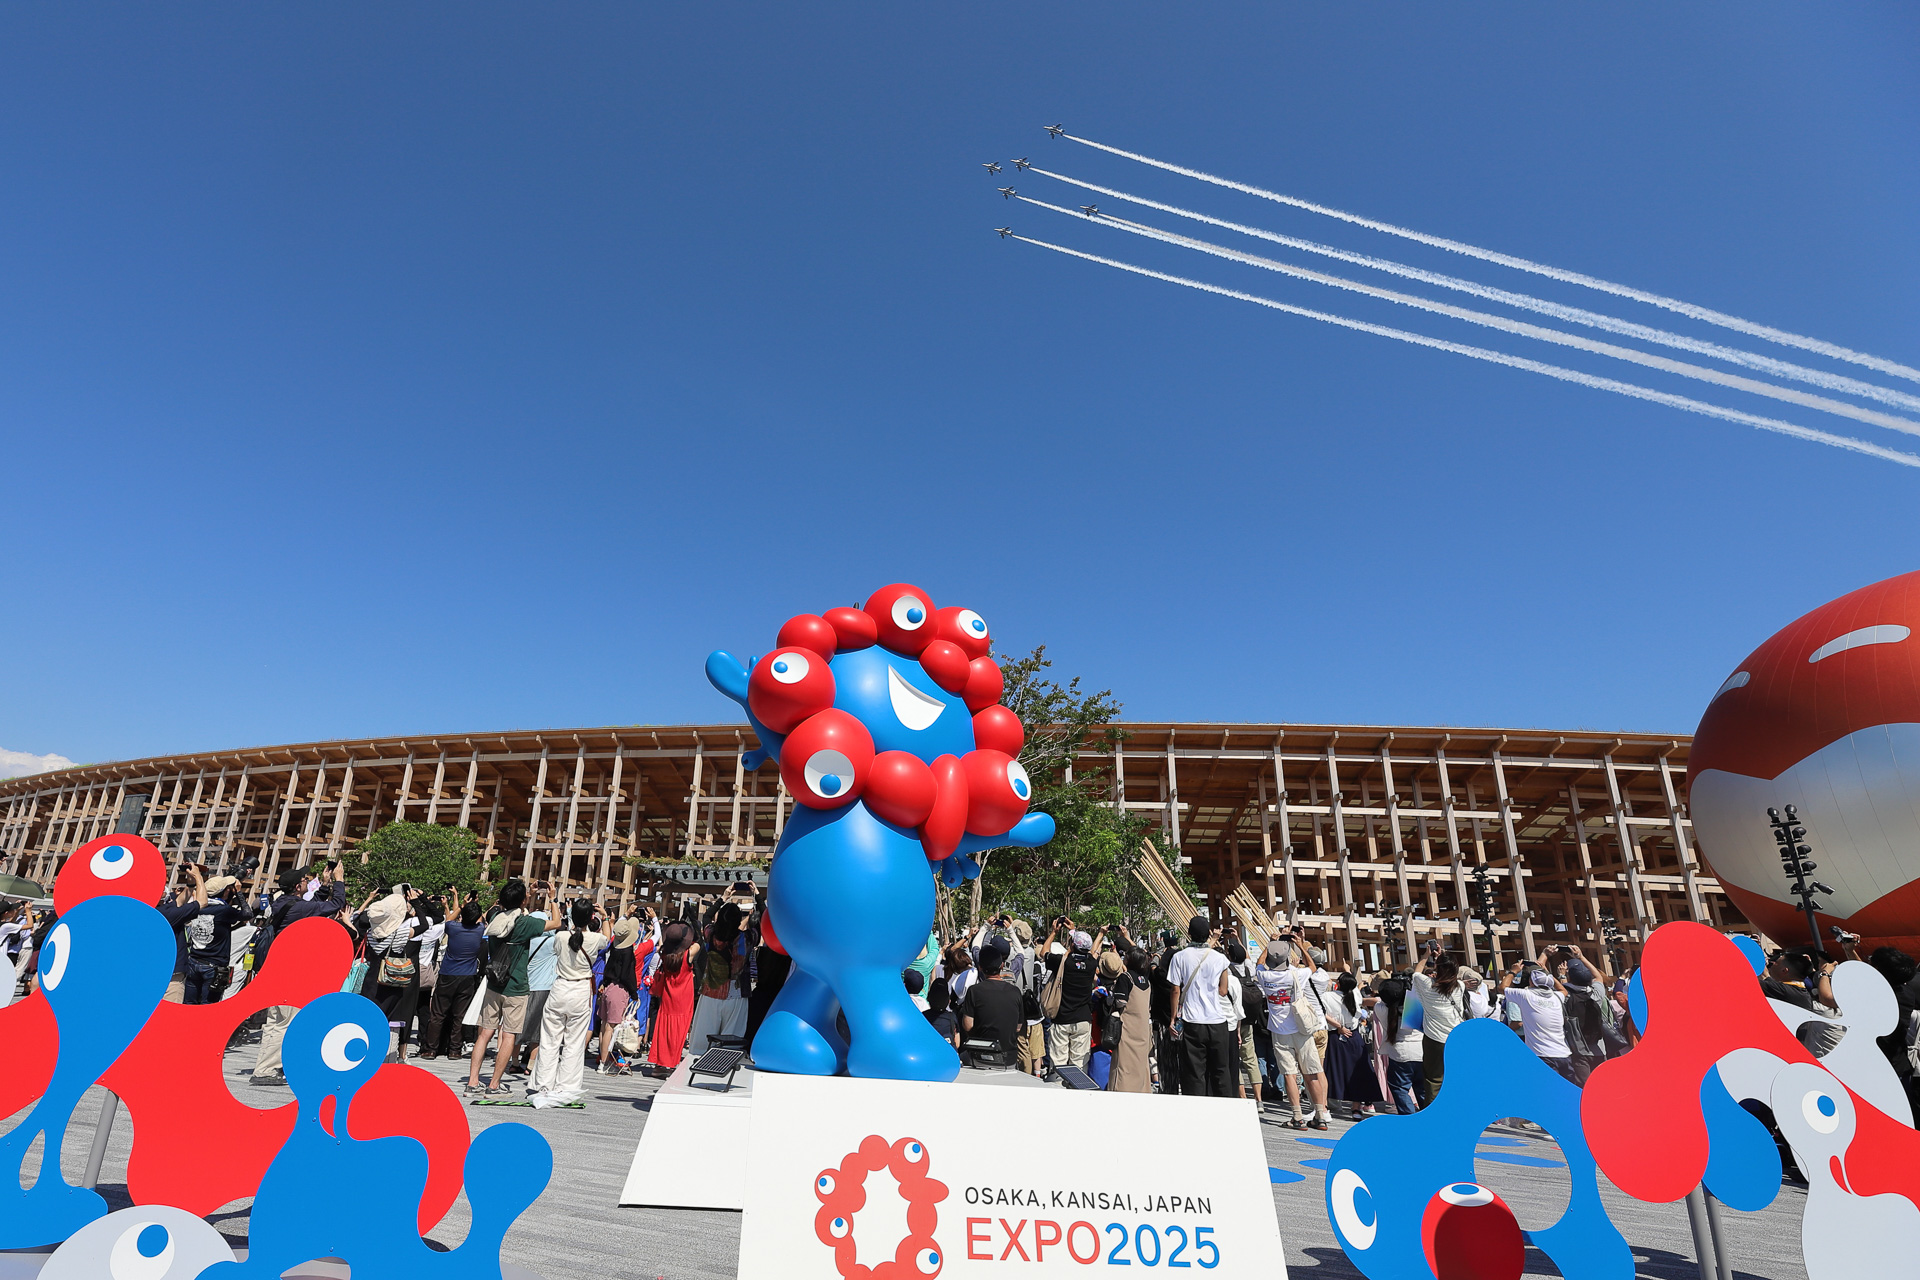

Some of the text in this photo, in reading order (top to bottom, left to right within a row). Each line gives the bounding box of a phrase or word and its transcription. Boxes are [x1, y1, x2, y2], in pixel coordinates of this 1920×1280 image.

[964, 1186, 1212, 1215] OSAKA, KANSAI, JAPAN
[966, 1216, 1221, 1270] EXPO2025
